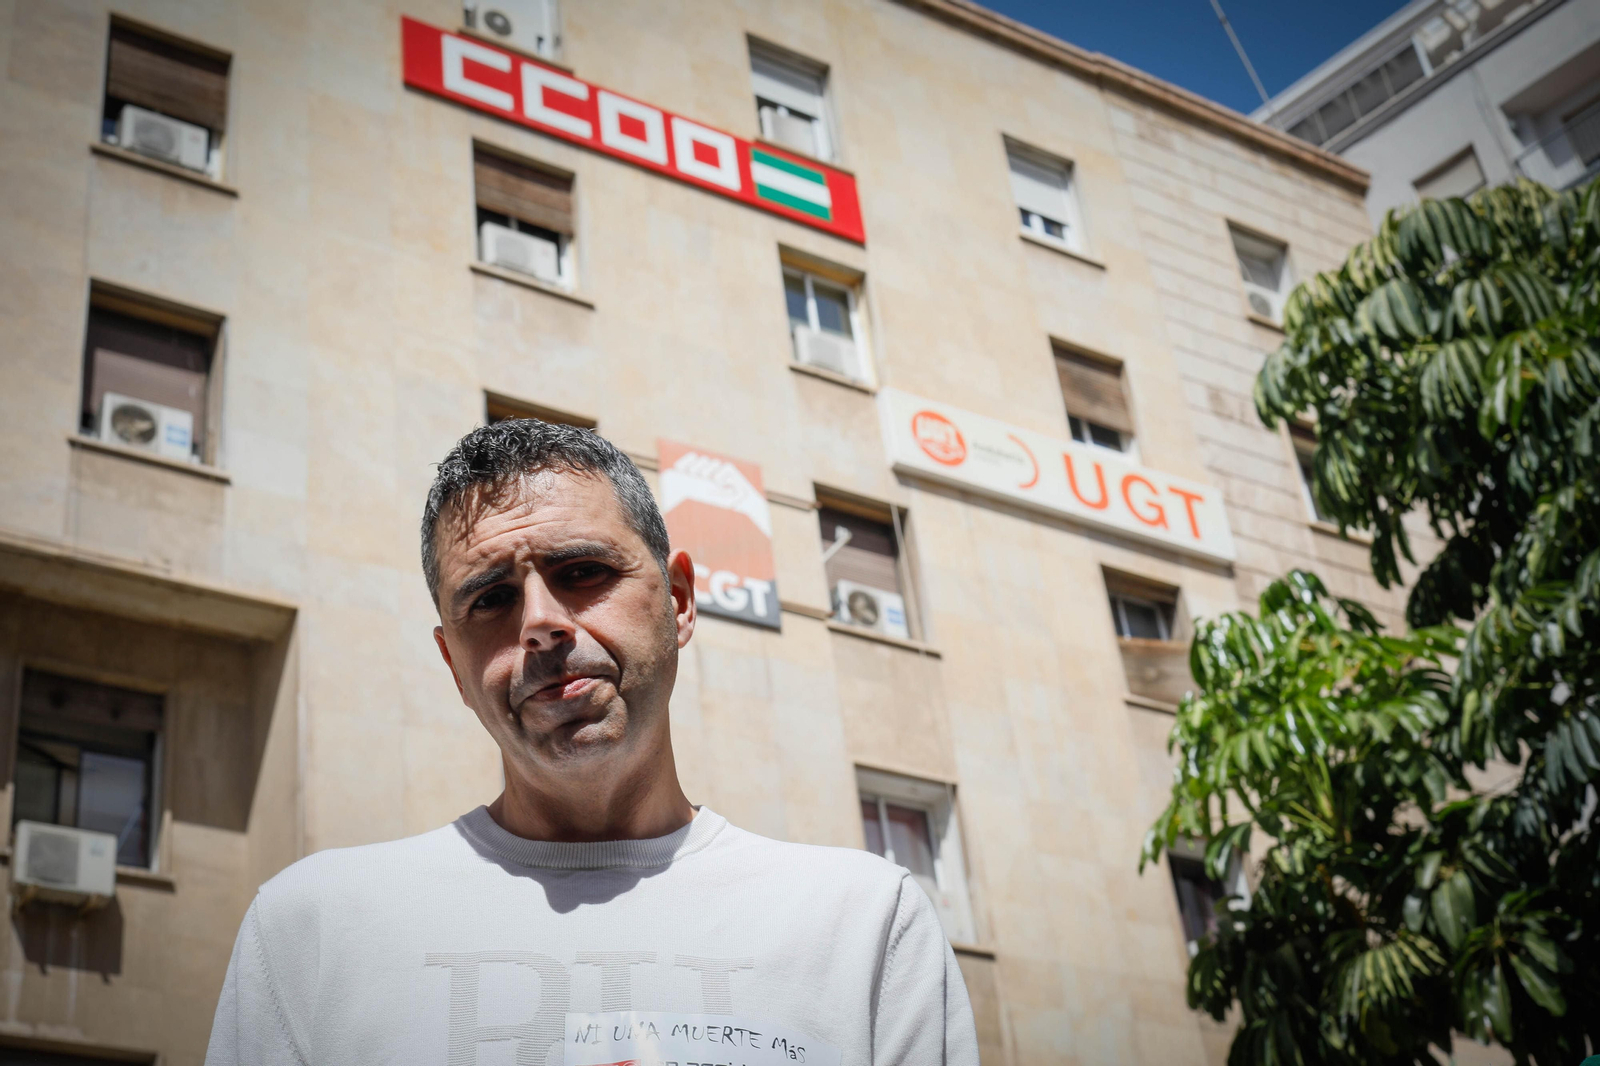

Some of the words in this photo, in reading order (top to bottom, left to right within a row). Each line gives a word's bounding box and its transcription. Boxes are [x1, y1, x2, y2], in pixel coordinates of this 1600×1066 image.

[441, 33, 742, 192] CCOO
[1063, 452, 1205, 540] UGT
[575, 1023, 602, 1045] NI
[671, 1023, 763, 1050] MUERTE
